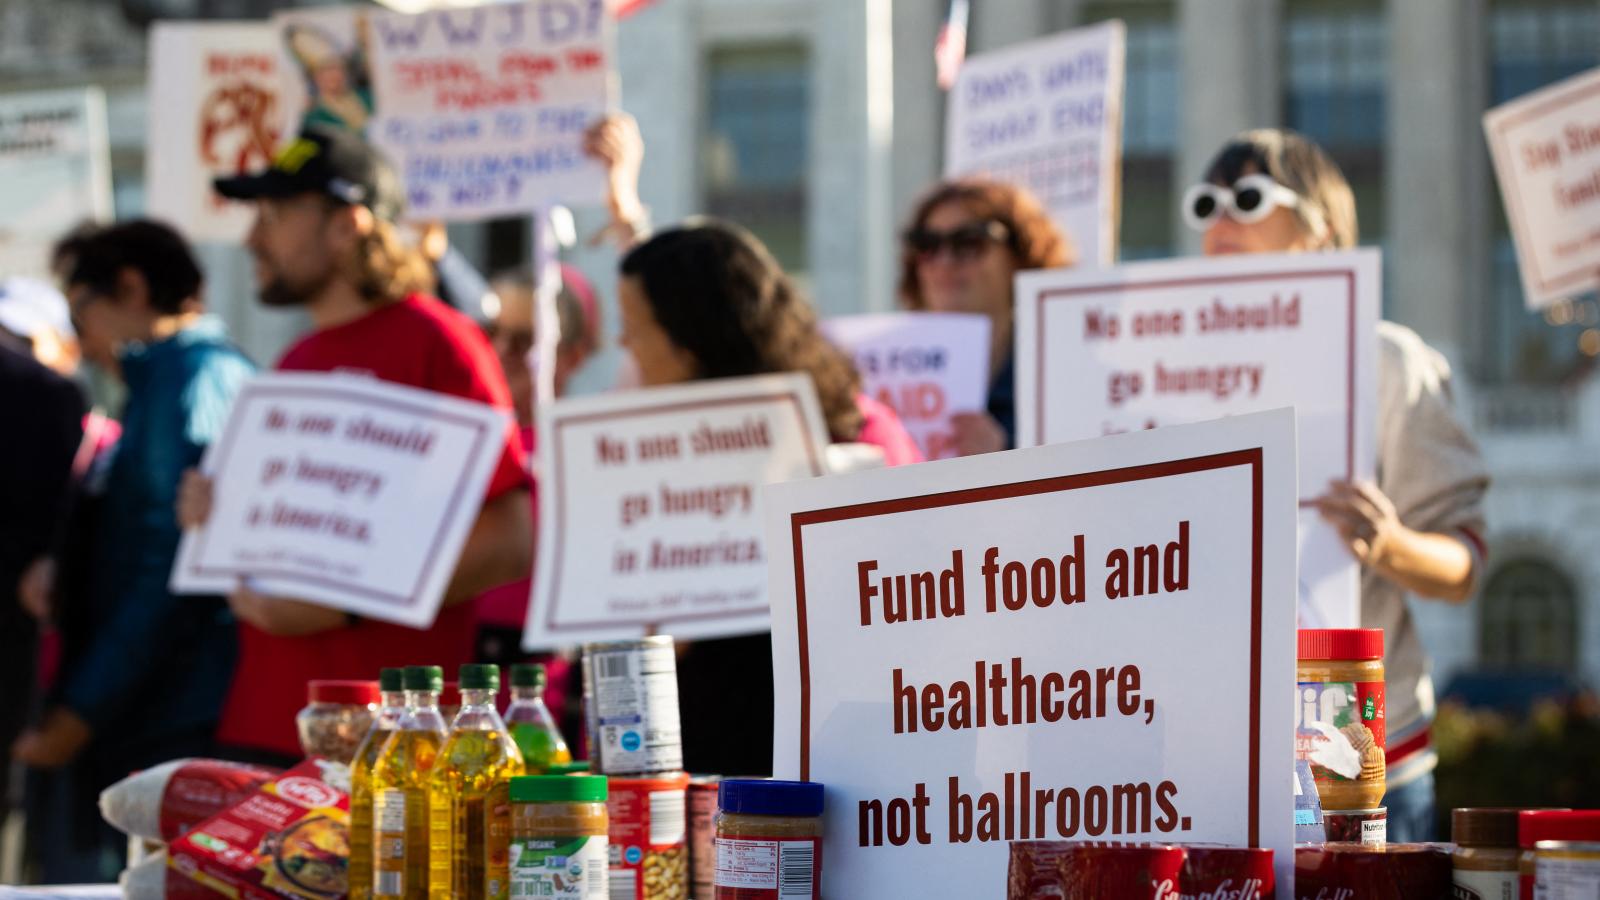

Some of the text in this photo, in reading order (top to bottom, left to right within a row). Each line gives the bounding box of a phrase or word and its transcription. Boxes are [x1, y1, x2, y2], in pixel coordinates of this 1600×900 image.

[1084, 294, 1302, 340] No one should
[889, 347, 947, 371] FOR
[1108, 361, 1264, 404] go hungry
[263, 406, 437, 458] No one should
[595, 419, 771, 463] No one should
[261, 453, 385, 496] go hungry
[621, 481, 753, 525] go hungry
[613, 538, 763, 574] in America.
[857, 520, 1191, 627] Fund food and
[892, 657, 1156, 734] healthcare,
[1296, 687, 1348, 730] if
[858, 771, 1193, 848] not ballrooms.
[527, 840, 556, 849] ORGANIC
